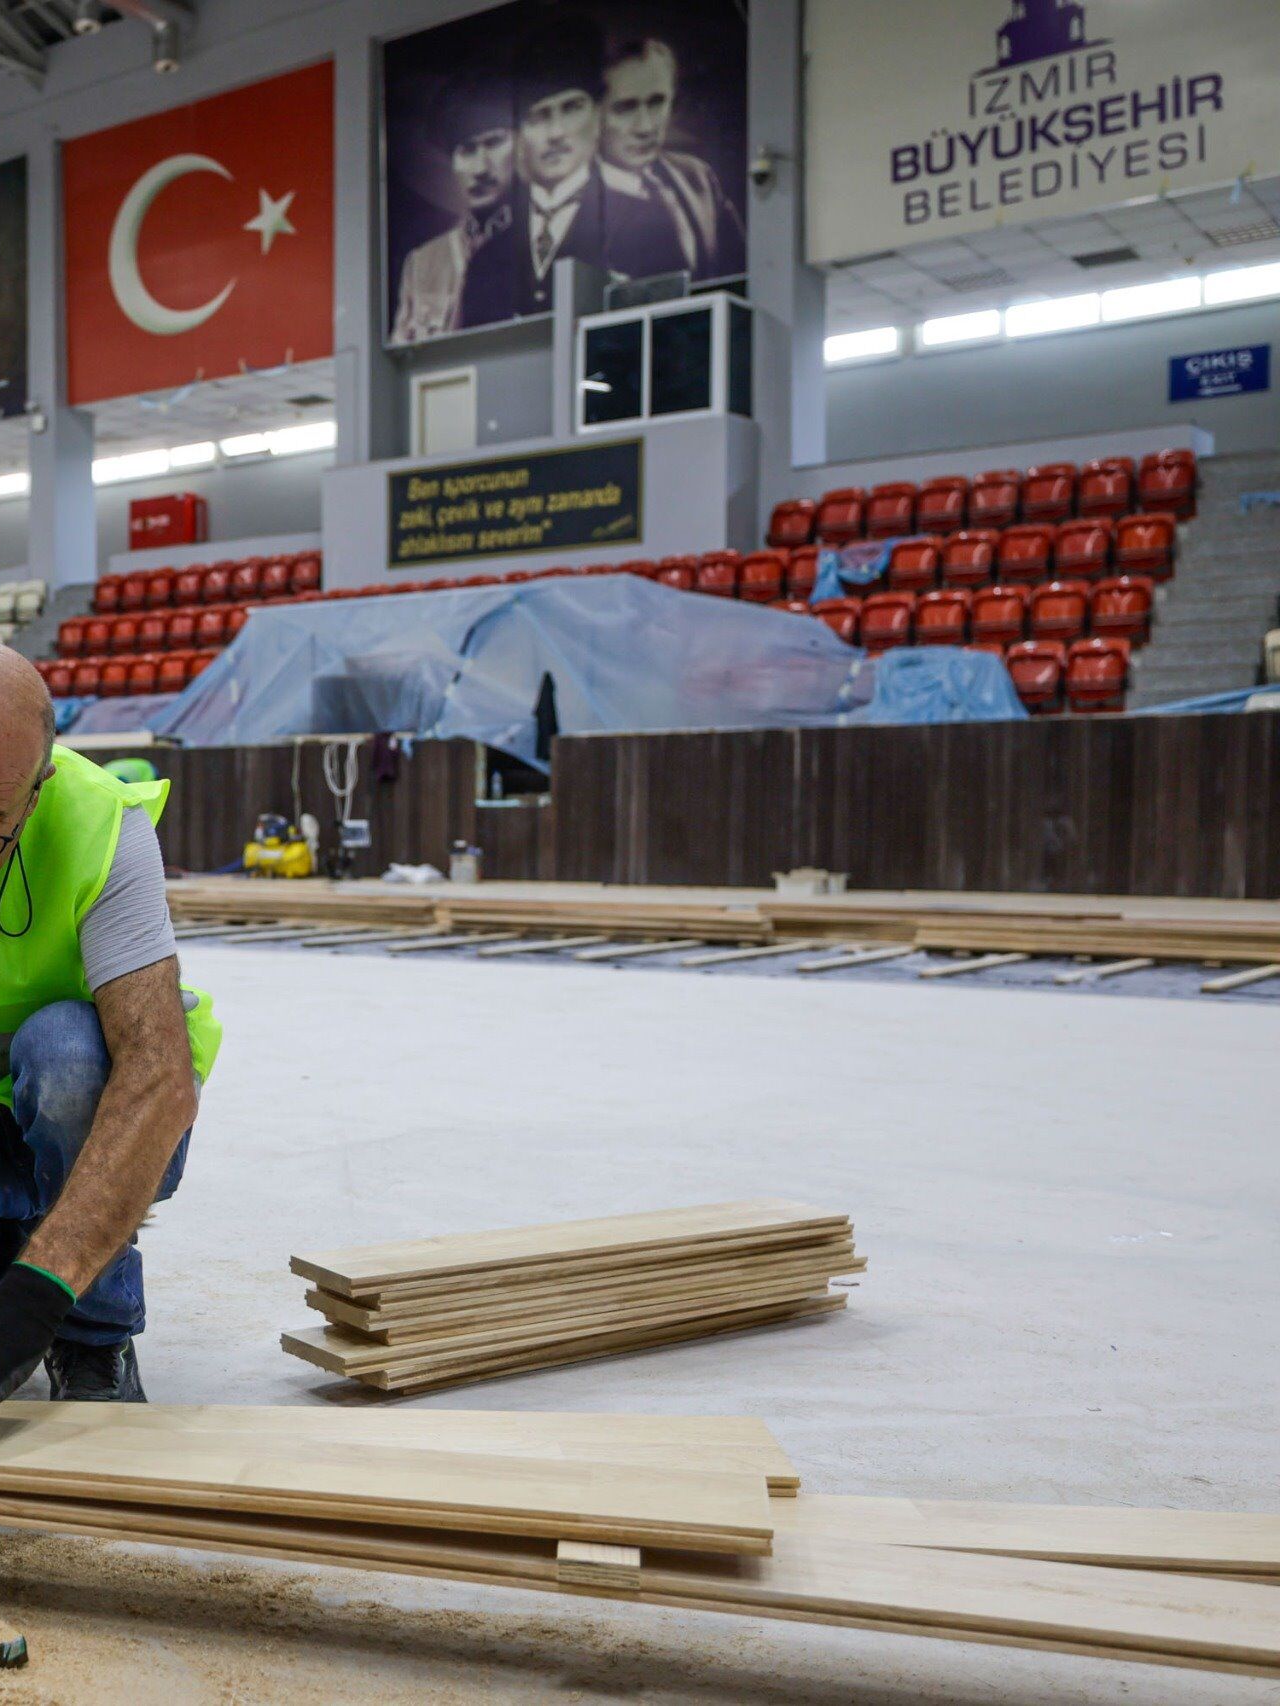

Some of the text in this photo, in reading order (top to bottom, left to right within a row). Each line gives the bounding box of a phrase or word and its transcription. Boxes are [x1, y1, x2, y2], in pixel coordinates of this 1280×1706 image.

[891, 73, 1224, 184] BÜYÜKŞEHİR
[968, 50, 1117, 118] İZMİR
[903, 123, 1207, 226] BELEDİYESİ
